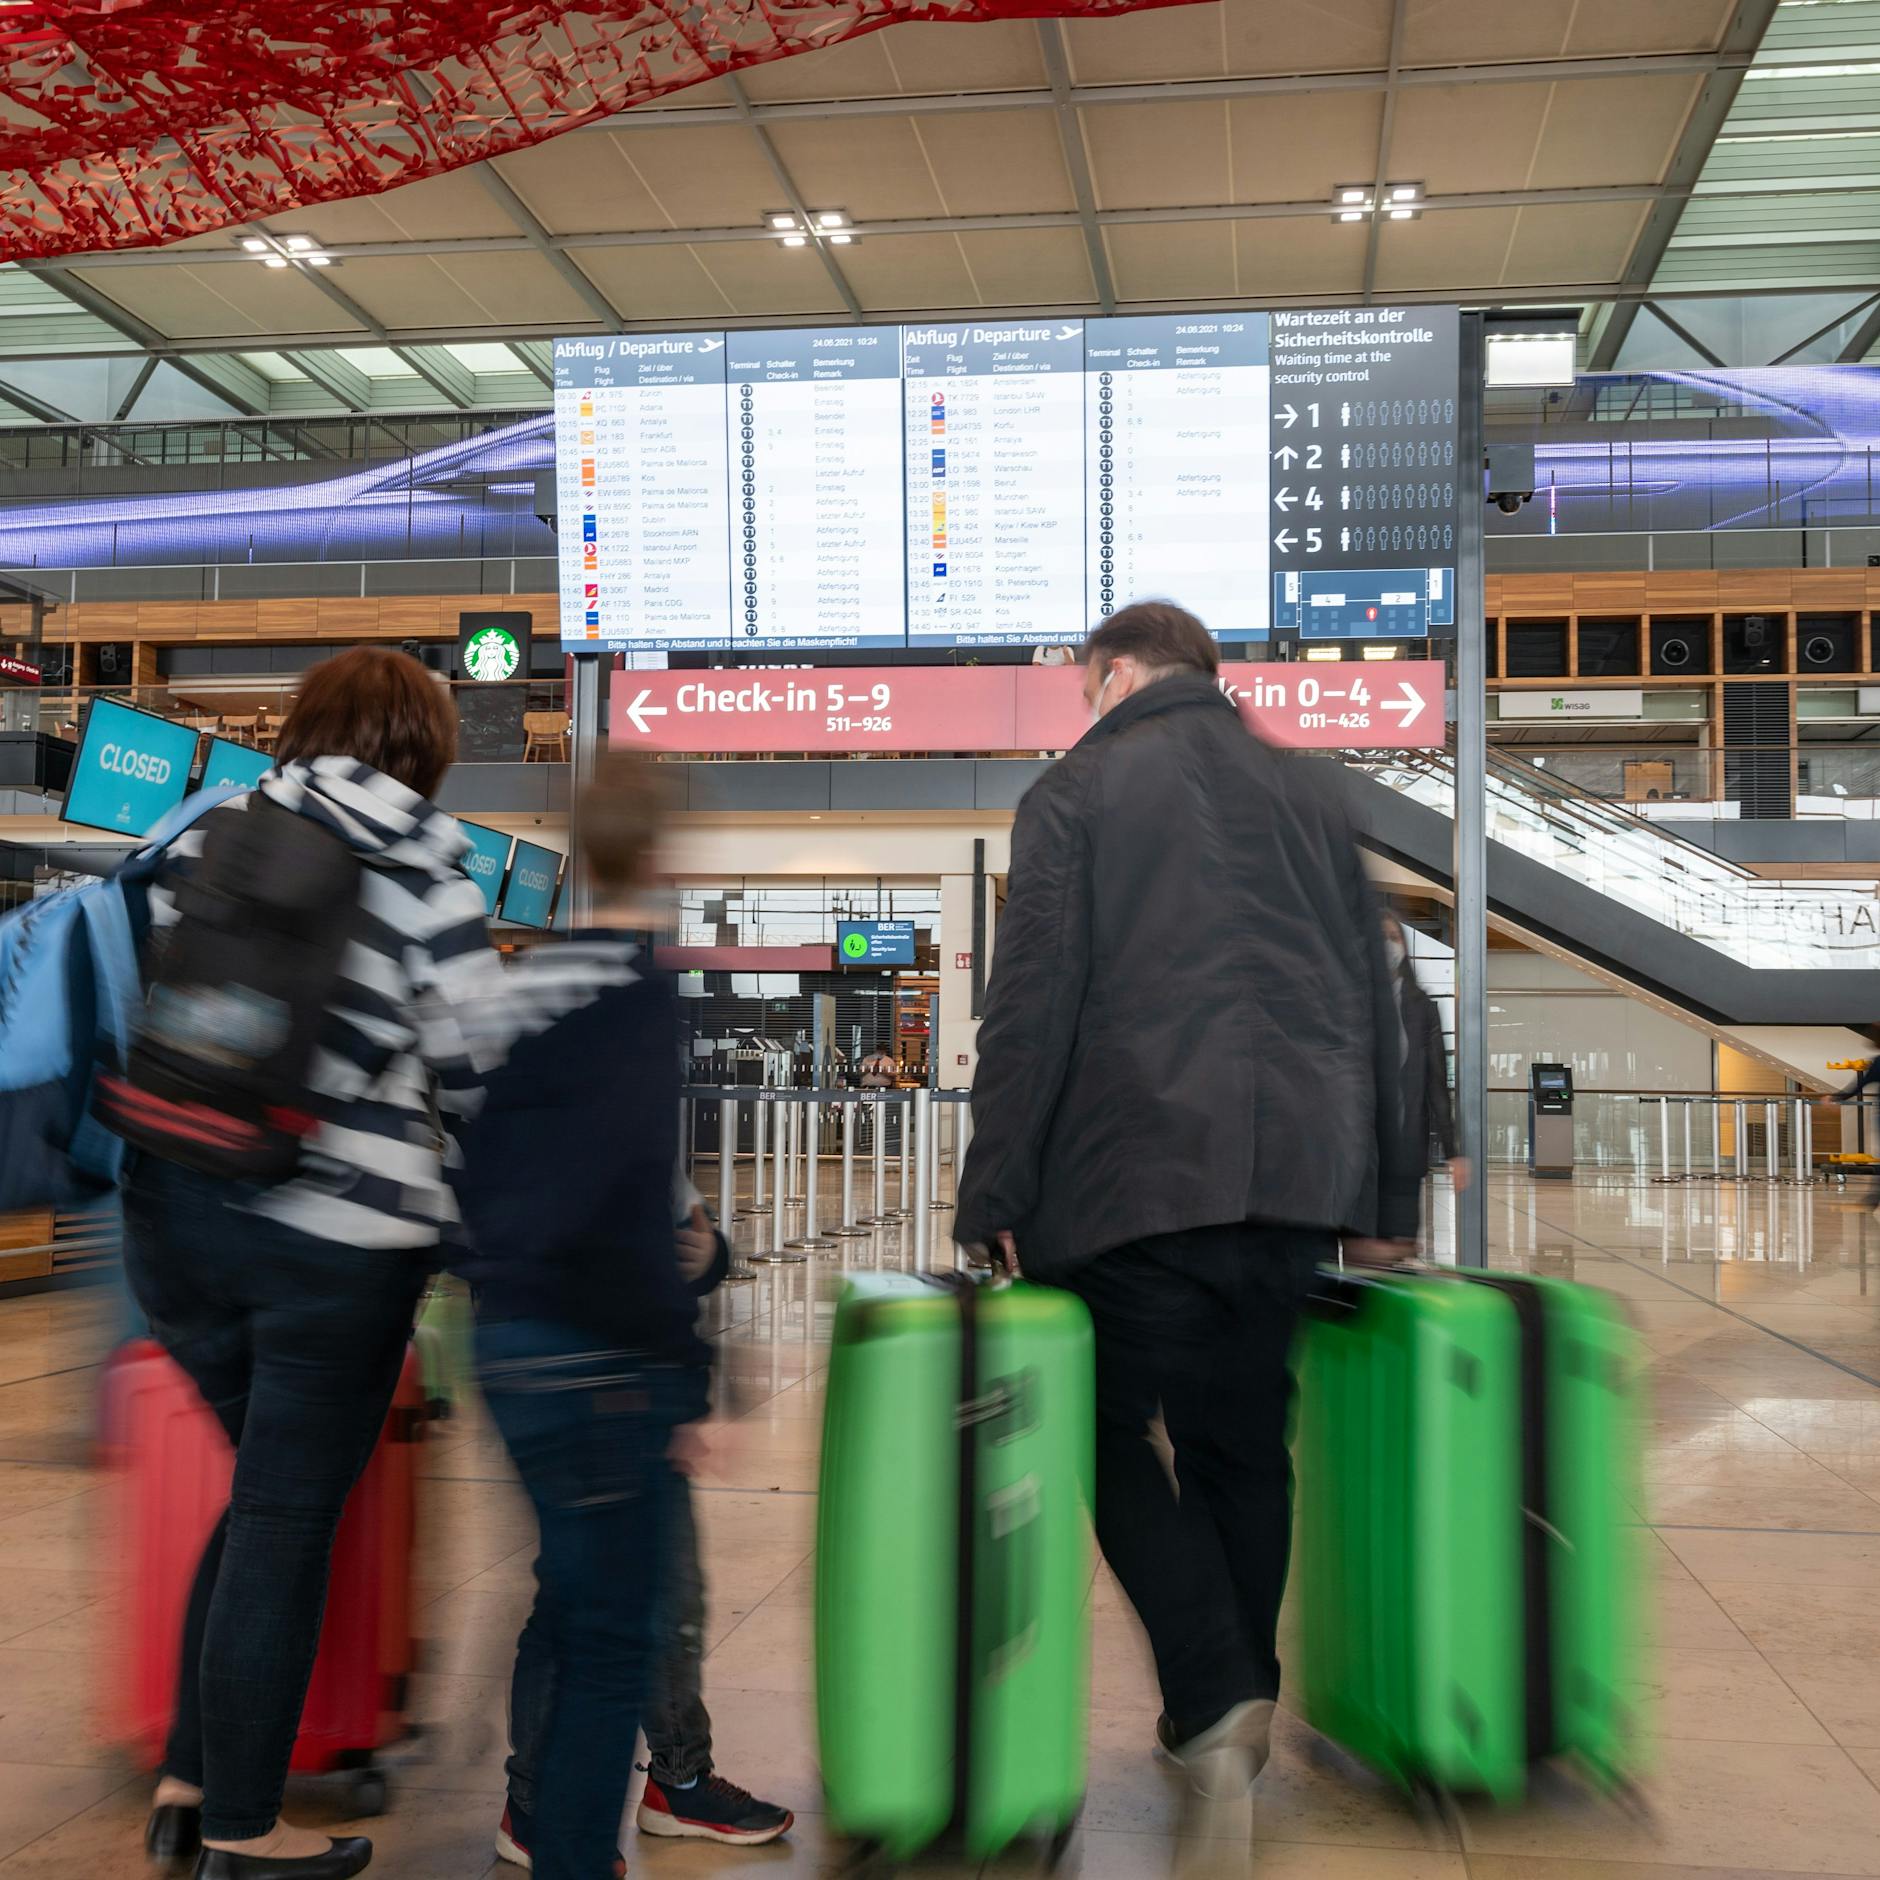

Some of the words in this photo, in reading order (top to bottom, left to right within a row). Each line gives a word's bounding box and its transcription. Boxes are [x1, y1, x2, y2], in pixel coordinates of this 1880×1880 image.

[1275, 311, 1351, 327] Wartezeit
[1355, 312, 1374, 324] an
[1379, 309, 1405, 322] der
[1222, 324, 1244, 332] 10:24
[857, 337, 878, 346] 10:24
[906, 329, 957, 348] Abflug
[961, 328, 970, 346] /
[973, 327, 1050, 346] Departure
[1275, 328, 1433, 347] Sicherheitskontrolle
[555, 342, 604, 360] Abflug
[608, 341, 616, 358] /
[620, 340, 693, 358] Departure
[1088, 349, 1120, 357] Terminal
[1127, 348, 1158, 356] Schalter
[1176, 346, 1219, 355] Bemerkung
[907, 356, 920, 364] Zeit
[946, 354, 963, 363] Flug
[992, 352, 1007, 360] Ziel
[1012, 351, 1029, 360] über
[1275, 353, 1321, 367] Waiting
[1324, 352, 1352, 364] time
[1355, 353, 1367, 363] at
[1371, 351, 1391, 362] the
[730, 361, 760, 369] Terminal
[767, 360, 796, 368] Schalter
[813, 358, 854, 367] Bemerkung
[1127, 359, 1160, 368] Check-in
[1176, 358, 1206, 366] Remark
[594, 366, 610, 375] Flug
[638, 364, 652, 372] Ziel
[657, 364, 673, 372] über
[947, 366, 967, 375] Flight
[993, 364, 1034, 373] Destination
[1039, 363, 1051, 371] via
[767, 371, 798, 379] Check-in
[814, 370, 842, 378] Remark
[1275, 371, 1323, 385] security
[1326, 369, 1369, 382] control
[556, 379, 573, 387] Time
[594, 377, 614, 386] Flight
[639, 376, 678, 384] Destination
[1024, 406, 1040, 414] LHR
[1307, 403, 1320, 428] 1
[640, 432, 672, 440] Frankfurt
[1306, 444, 1322, 469] 2
[642, 474, 655, 482] Kos
[642, 488, 664, 496] Palma
[677, 487, 708, 495] Mallorca
[1305, 486, 1324, 510] 4
[642, 530, 680, 538] Stockholm
[682, 529, 698, 537] ARN
[994, 536, 1028, 544] Marseille
[1306, 528, 1322, 553] 5
[643, 544, 671, 552] Istanbul
[674, 543, 697, 552] Airport
[1007, 579, 1049, 588] Petersburg
[644, 599, 662, 607] Paris
[664, 599, 682, 607] CDG
[644, 613, 666, 621] Palma
[608, 641, 626, 649] Bitte
[628, 640, 652, 648] halten
[656, 640, 669, 648] Sie
[671, 640, 705, 648] Abstand
[767, 638, 780, 646] Sie
[783, 638, 795, 646] die
[797, 637, 857, 648] Maskenpflicht!
[956, 636, 976, 644] Bitte
[978, 635, 1004, 643] halten
[1006, 635, 1020, 643] Sie
[1060, 634, 1077, 642] und
[1218, 677, 1286, 707] k-in
[677, 682, 816, 712] Check-in
[100, 743, 171, 784] CLOSED
[464, 853, 496, 876] LOSED
[519, 868, 549, 891] CLOSED
[877, 923, 895, 931] BER
[760, 1092, 776, 1100] BER
